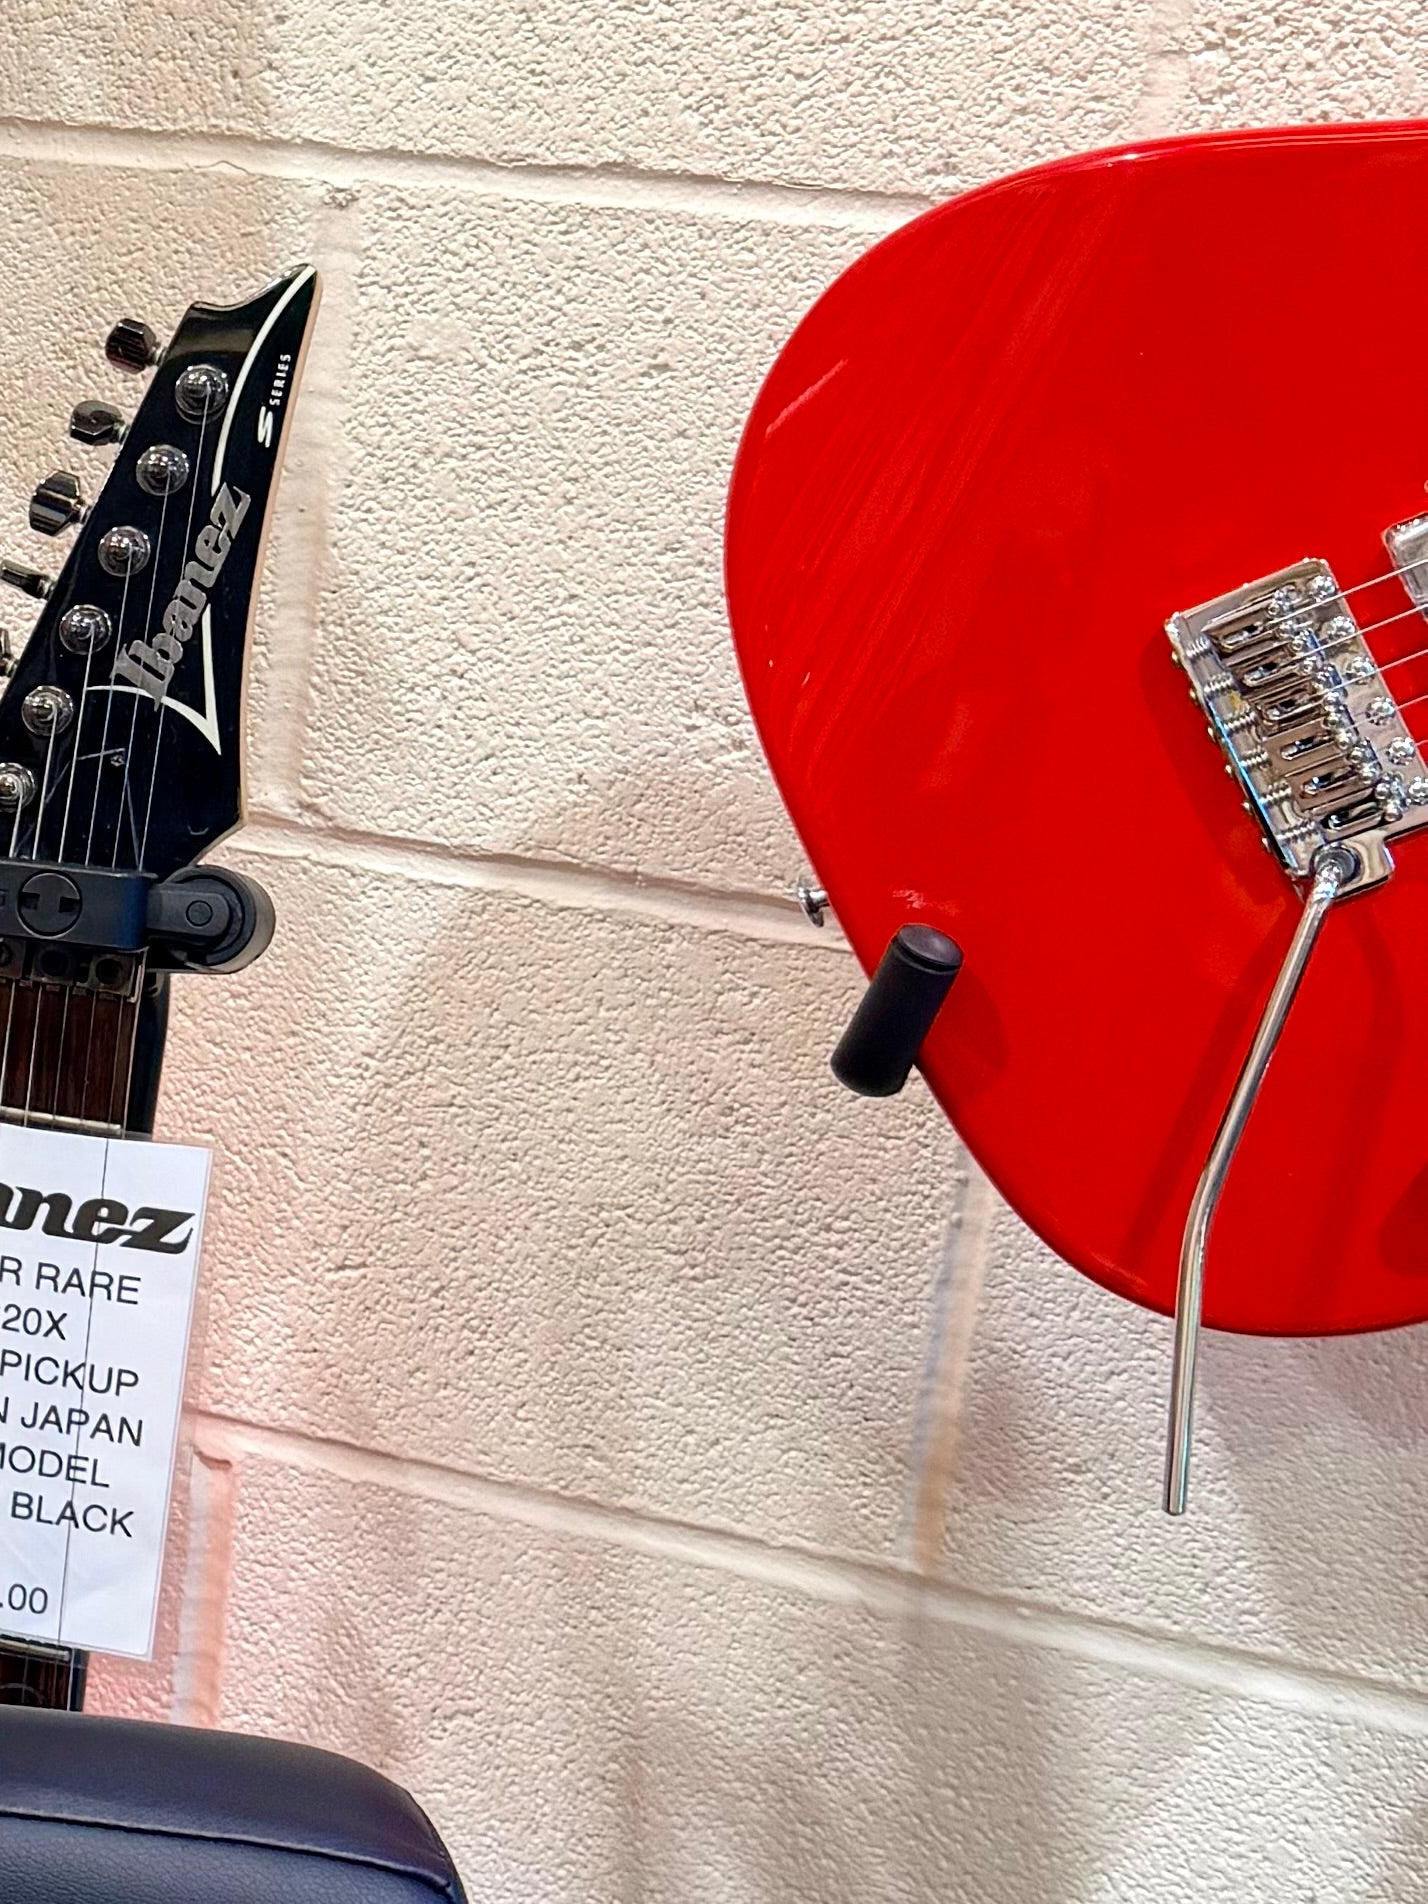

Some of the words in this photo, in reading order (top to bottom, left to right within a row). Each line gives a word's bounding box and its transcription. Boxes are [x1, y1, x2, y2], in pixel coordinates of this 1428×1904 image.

[268, 354, 292, 406] SERIES
[111, 482, 252, 710] Ibanez
[34, 1263, 142, 1307] RARE
[20, 1400, 144, 1449] JAPAN
[10, 1491, 135, 1539] BLACK
